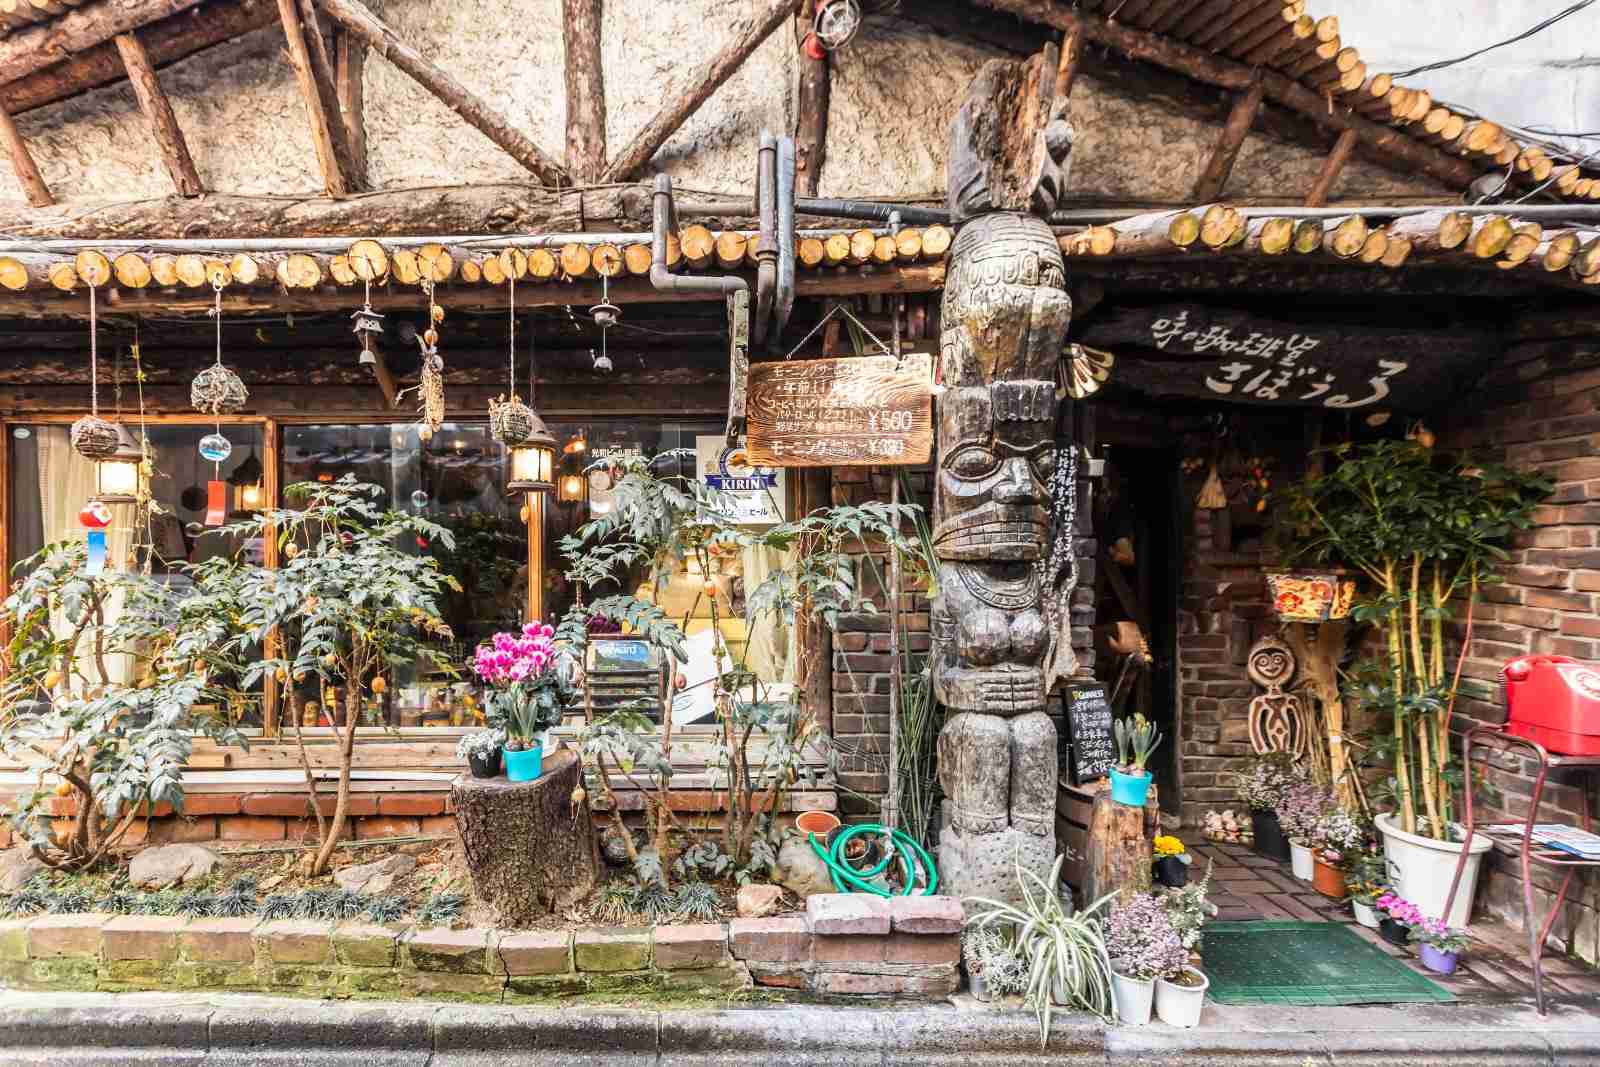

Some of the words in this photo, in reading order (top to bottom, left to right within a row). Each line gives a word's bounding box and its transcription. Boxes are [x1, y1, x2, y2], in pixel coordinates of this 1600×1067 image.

[1205, 359, 1408, 409] さぼうる
[721, 479, 760, 490] KIRIN
